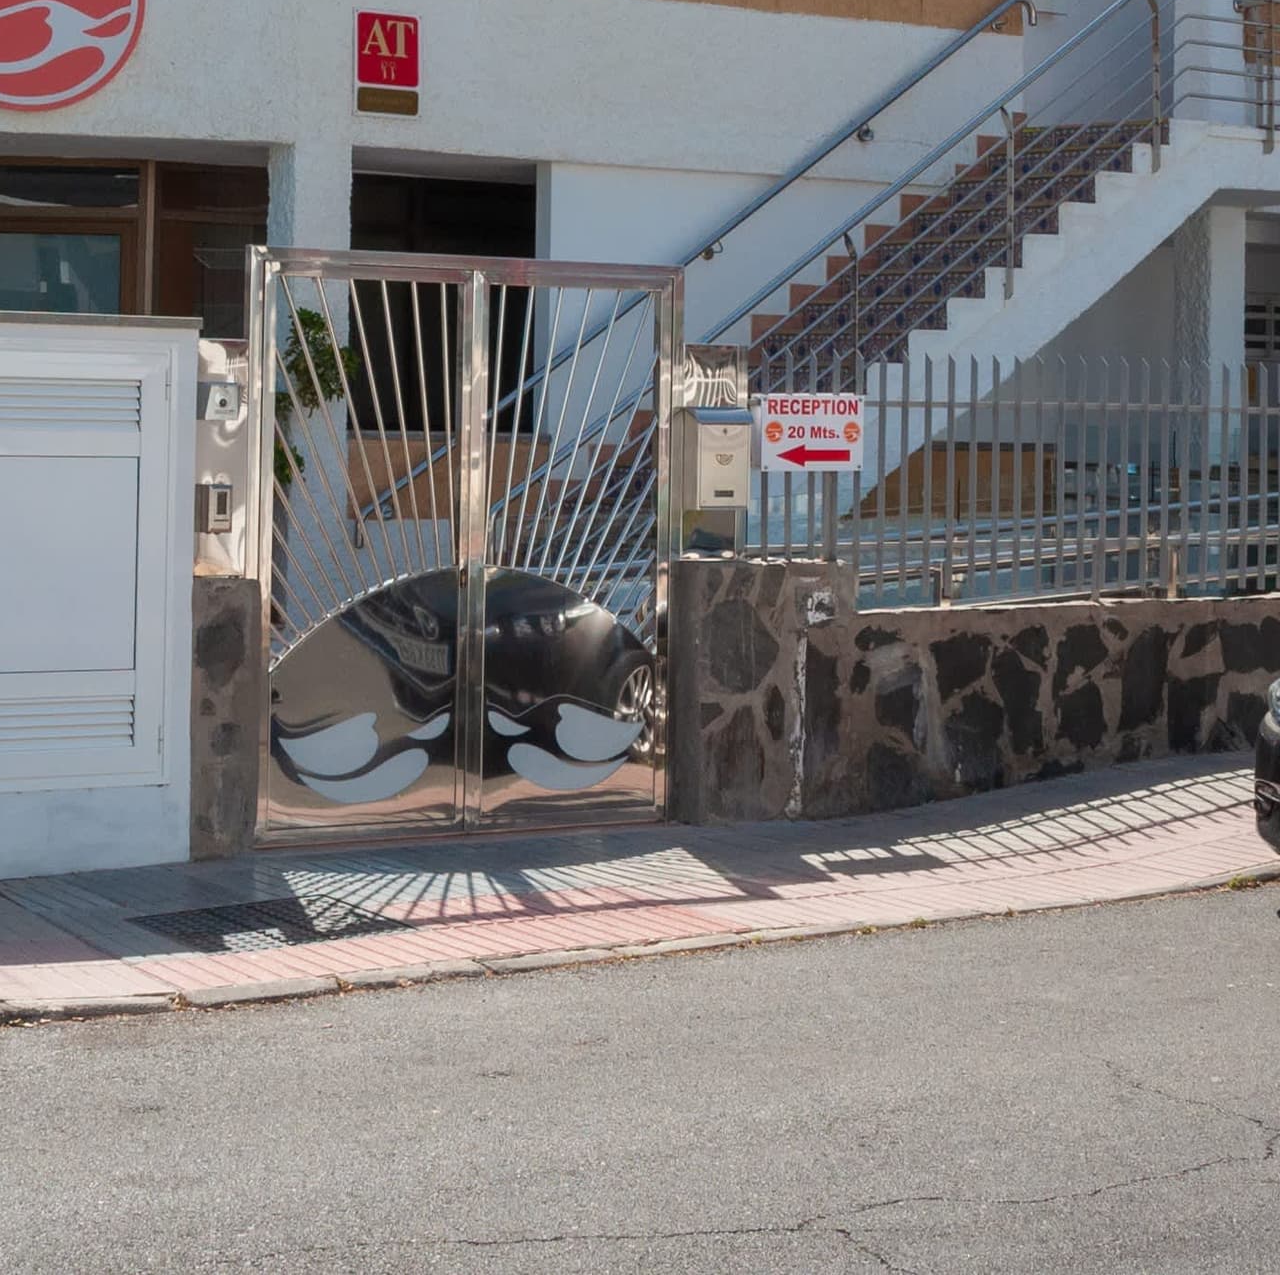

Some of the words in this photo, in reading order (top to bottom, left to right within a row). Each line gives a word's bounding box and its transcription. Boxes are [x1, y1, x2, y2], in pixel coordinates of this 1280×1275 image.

[361, 18, 415, 59] AT
[767, 399, 859, 415] RECEPTION
[787, 426, 806, 439] 20
[810, 426, 840, 439] Mts.
